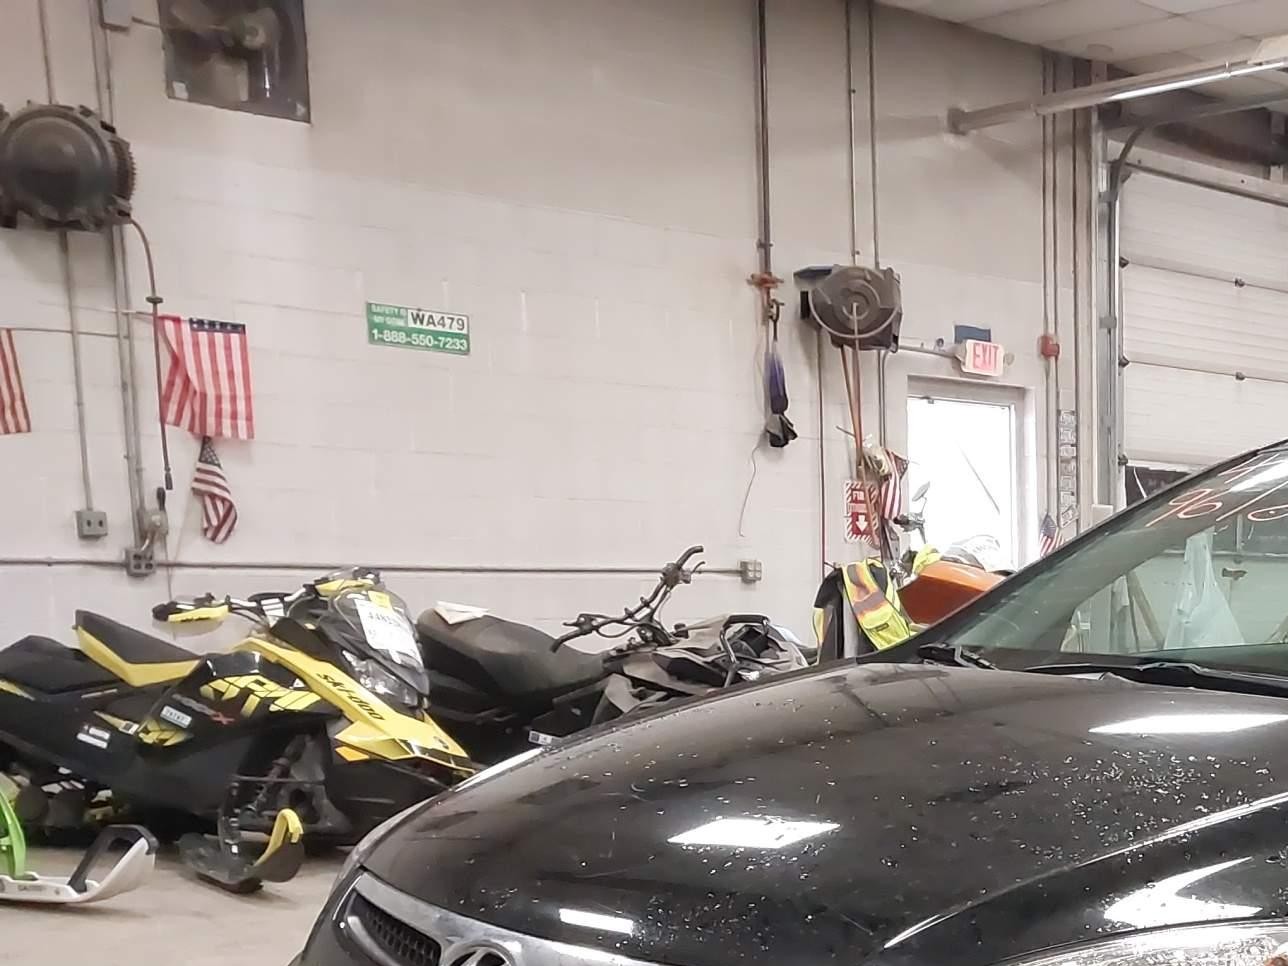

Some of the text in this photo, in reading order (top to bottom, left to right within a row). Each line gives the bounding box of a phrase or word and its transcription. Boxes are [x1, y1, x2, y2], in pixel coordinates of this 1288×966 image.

[411, 311, 465, 331] WA479
[372, 328, 467, 350] 1-888-550-7233
[973, 342, 999, 369] EXIT
